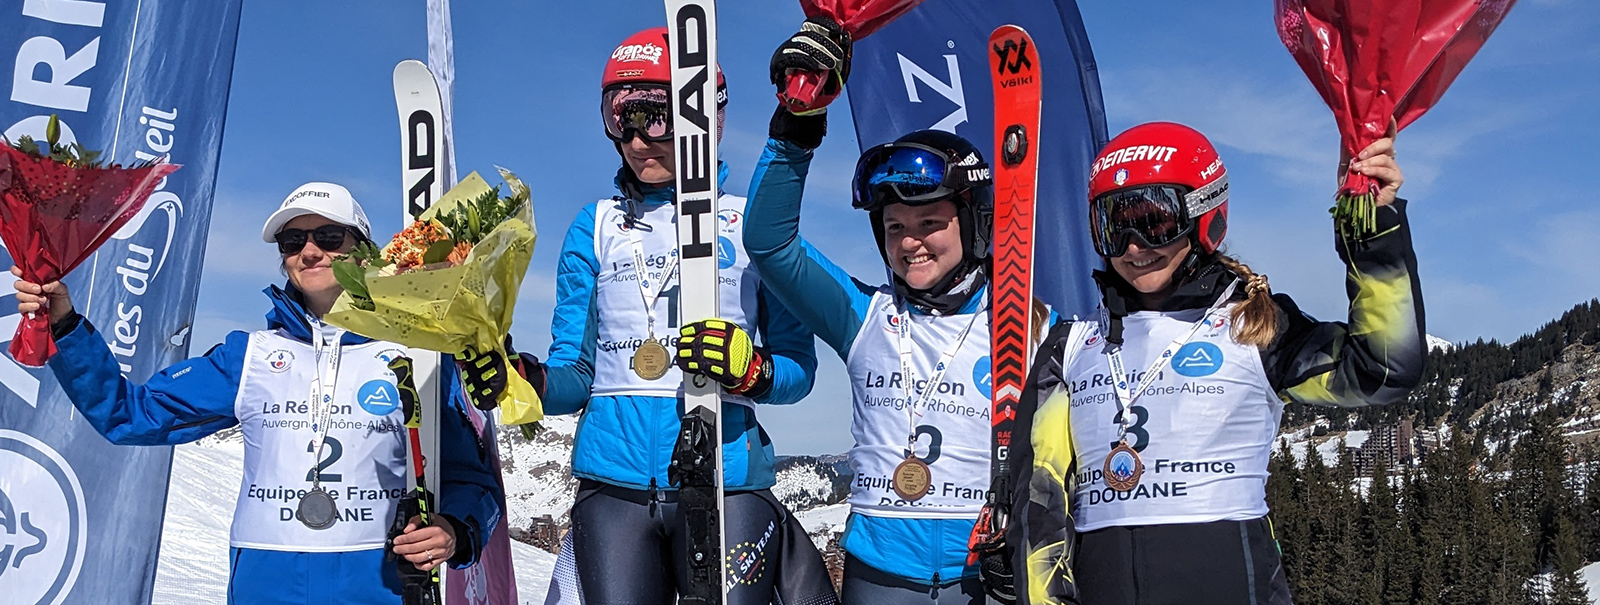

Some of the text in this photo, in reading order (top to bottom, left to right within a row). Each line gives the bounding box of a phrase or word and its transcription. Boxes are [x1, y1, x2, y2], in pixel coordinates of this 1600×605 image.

[1001, 76, 1032, 89] Völkl
[717, 88, 727, 103] ex
[676, 4, 712, 259] HEAD
[408, 110, 436, 218] AD
[1102, 145, 1178, 171] ENERVIT
[967, 168, 991, 181] uve
[116, 243, 154, 296] du
[658, 285, 678, 328] 1
[866, 371, 885, 389] La
[1071, 380, 1088, 394] La
[262, 401, 281, 415] La
[285, 400, 352, 415] Réon
[261, 418, 400, 433] Auvergnhône-Alpes
[1110, 405, 1149, 454] 3
[306, 436, 343, 482] 2
[1155, 459, 1236, 474] France
[857, 472, 894, 493] Equip
[324, 486, 340, 500] e
[347, 485, 408, 501] France
[1089, 481, 1188, 506] DOUANE
[280, 507, 374, 522] DANE
[740, 551, 757, 574] SKI
[756, 520, 775, 553] TEAM
